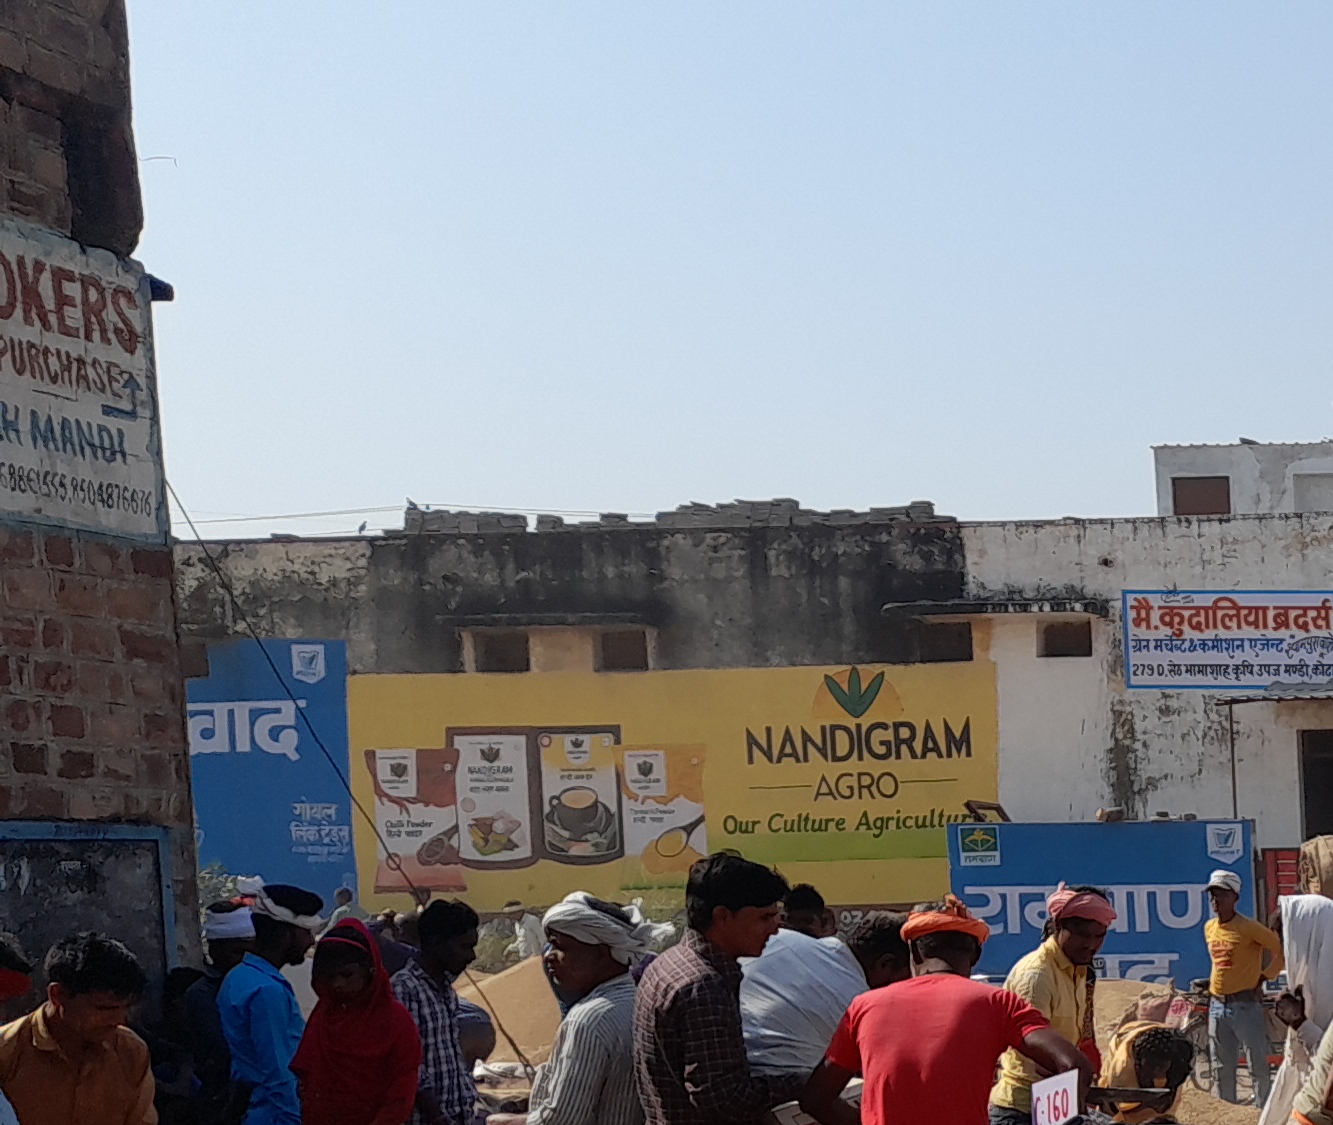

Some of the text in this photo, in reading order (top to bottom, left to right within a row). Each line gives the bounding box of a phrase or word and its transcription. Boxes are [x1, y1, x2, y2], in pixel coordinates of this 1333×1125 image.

[30, 409, 127, 465] MANDI
[1272, 599, 1333, 633] ब्रदर्स
[1188, 636, 1199, 653] &
[1132, 664, 1154, 676] 279
[745, 716, 973, 765] NANDIGRAM
[814, 771, 899, 801] AGRO
[723, 815, 761, 834] Our
[767, 811, 846, 834] Culture
